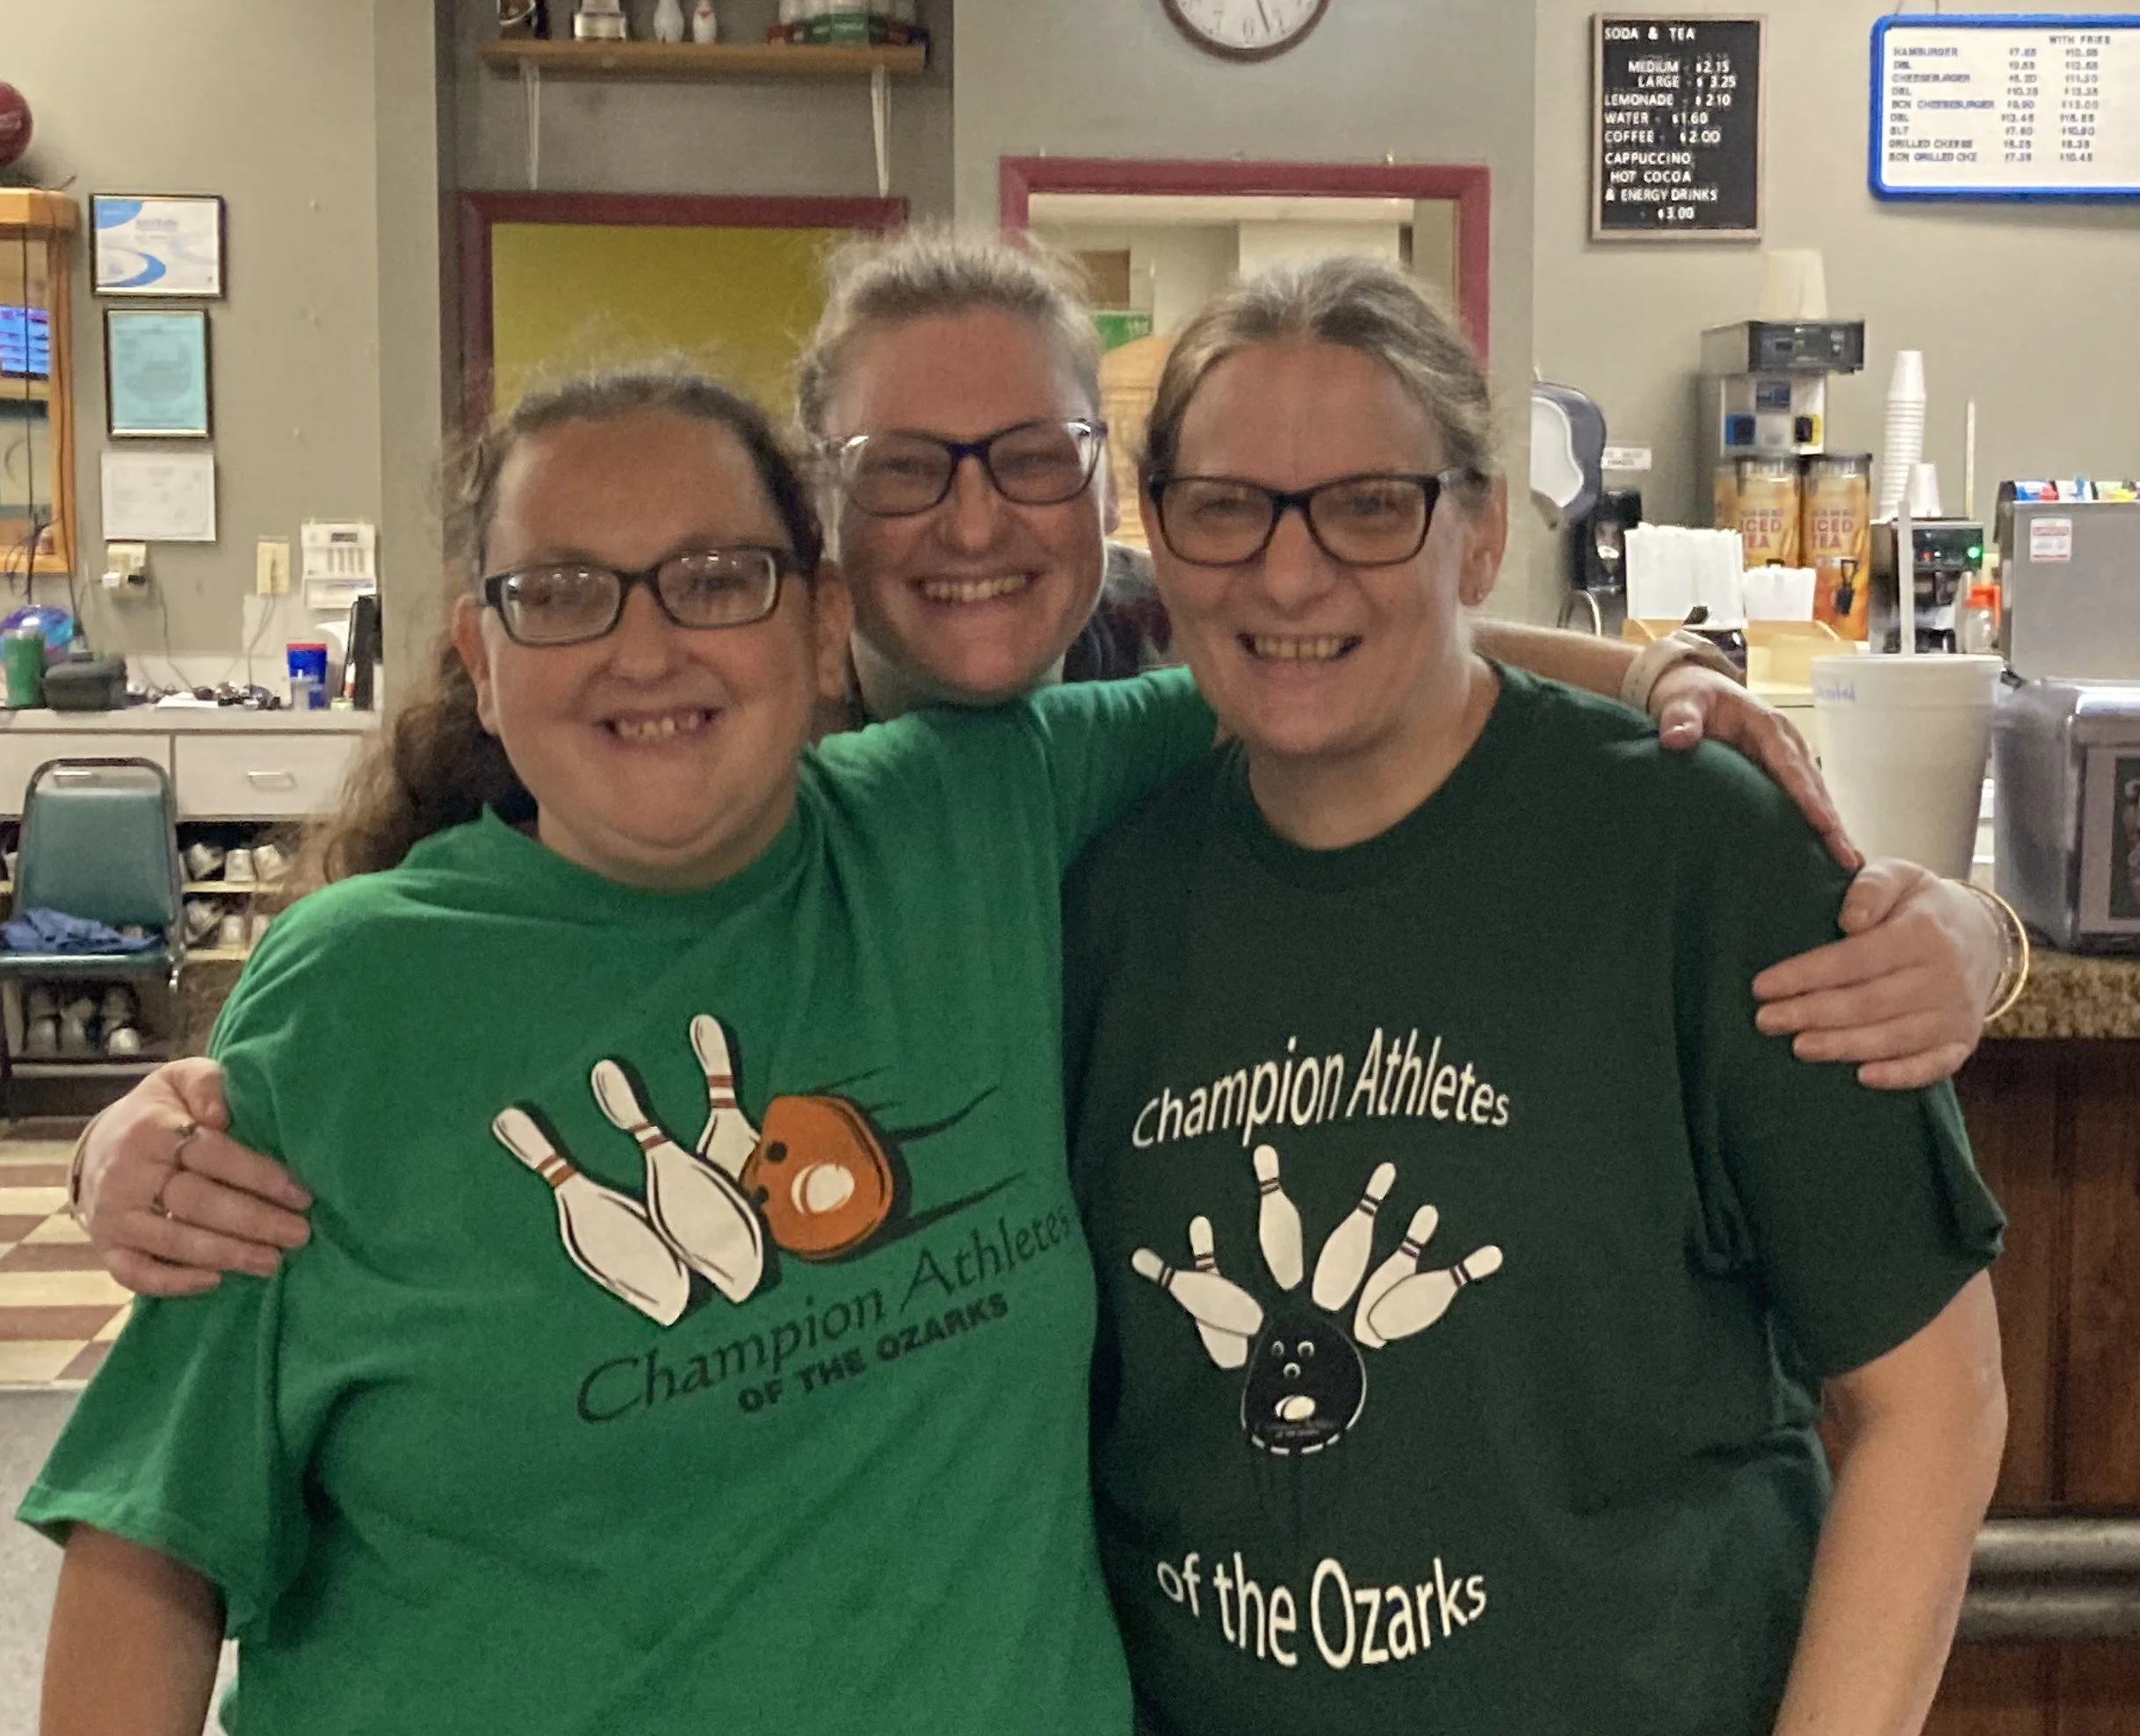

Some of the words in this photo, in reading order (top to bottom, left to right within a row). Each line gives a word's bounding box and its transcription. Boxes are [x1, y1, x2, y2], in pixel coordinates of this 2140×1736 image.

[1604, 27, 1638, 40] SODA
[1648, 26, 1659, 40] &
[1669, 27, 1695, 41] TEA
[2049, 35, 2075, 45] WITH
[1893, 47, 1958, 57] HAMBURGER
[1628, 60, 1680, 72] MEDIUM
[1638, 76, 1680, 88] LARGE
[1604, 93, 1674, 106] LEMONADE
[1604, 112, 1649, 124] WATER
[1604, 130, 1654, 142] COFFEE
[1604, 152, 1691, 164] CAPPUCCINO
[1609, 170, 1637, 183] HOT
[1643, 170, 1691, 183] COCOA
[1605, 188, 1615, 201] &
[1620, 188, 1668, 201] ENERGY
[1670, 188, 1718, 201] DRINKS
[1133, 1035, 1345, 1147] Champion
[1346, 1027, 1510, 1128] Athletes
[576, 1288, 886, 1426] Champion
[736, 1375, 784, 1415] OF
[798, 1345, 868, 1395] THE
[877, 1291, 1009, 1363] OZARKS
[1156, 1552, 1203, 1617] of
[1212, 1552, 1298, 1667] the
[1310, 1558, 1487, 1670] Ozarks
